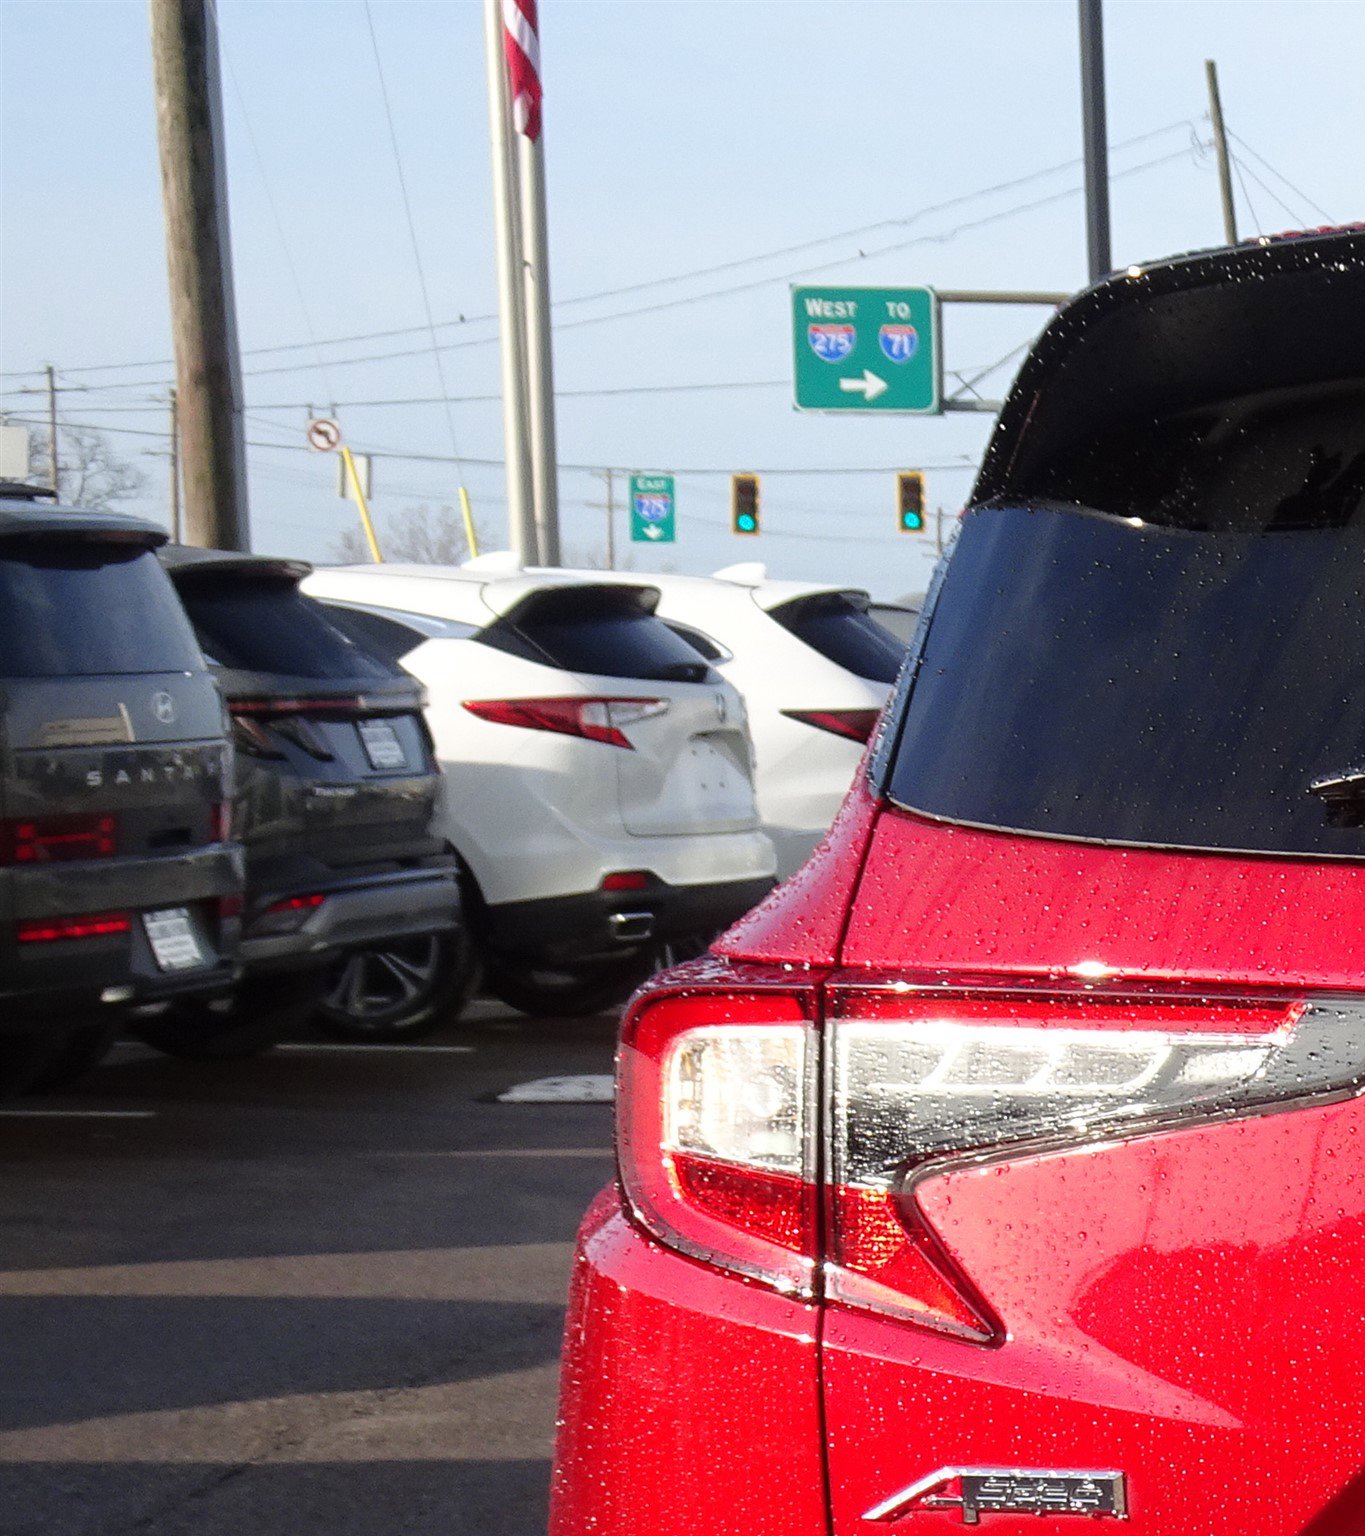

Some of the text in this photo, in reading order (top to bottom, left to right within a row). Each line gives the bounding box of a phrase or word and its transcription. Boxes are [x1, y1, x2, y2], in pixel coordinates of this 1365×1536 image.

[805, 298, 911, 320] WEST TO
[814, 334, 911, 355] 275 71
